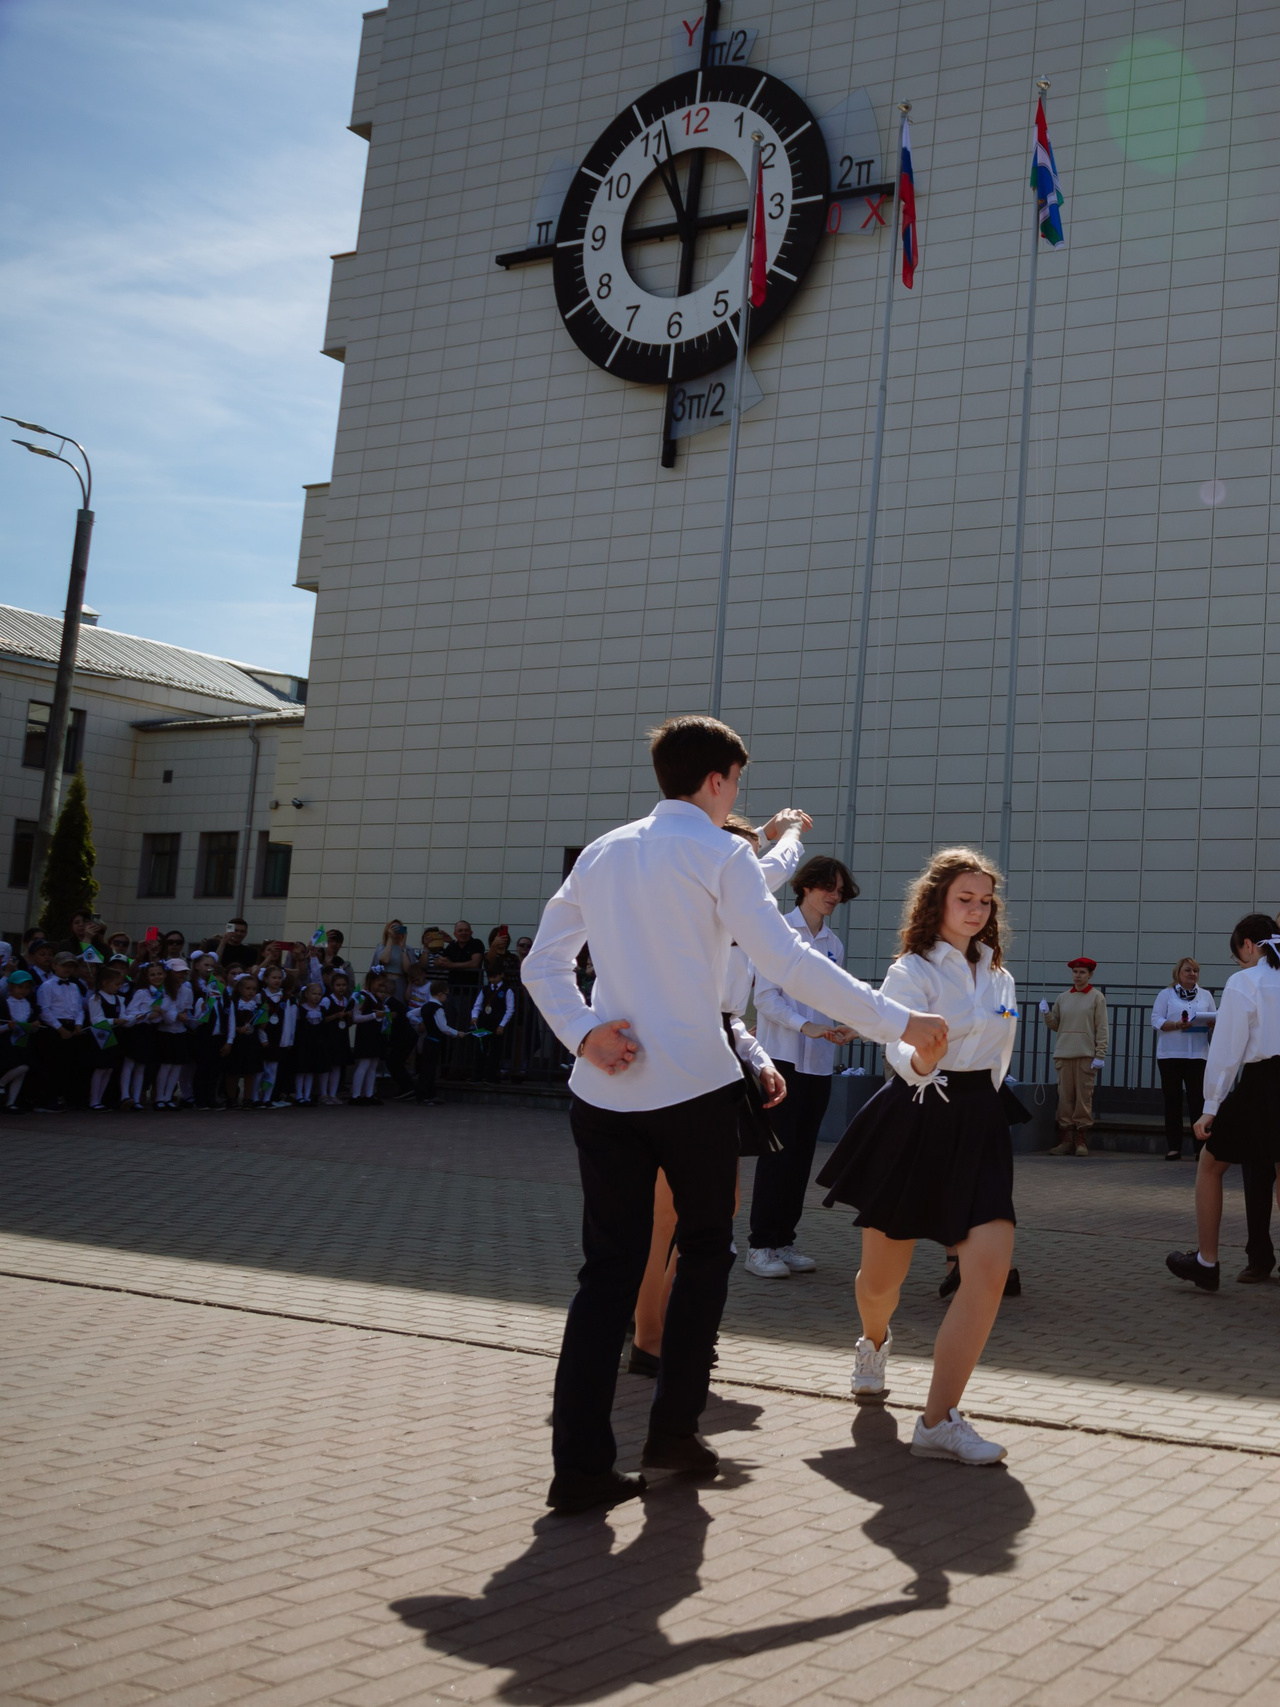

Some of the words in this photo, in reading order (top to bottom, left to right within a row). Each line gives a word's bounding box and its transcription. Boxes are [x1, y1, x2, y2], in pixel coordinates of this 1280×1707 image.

[681, 17, 704, 47] Y
[681, 107, 709, 136] 12
[734, 112, 745, 138] 1
[640, 129, 663, 157] 11
[760, 143, 777, 169] 2
[837, 155, 875, 189] 2π
[604, 172, 631, 202] 10
[768, 192, 785, 220] 3
[860, 195, 888, 229] X
[590, 224, 606, 251] 9
[597, 273, 612, 299] 8
[712, 289, 729, 318] 5
[625, 304, 641, 332] 7
[666, 312, 682, 339] 6
[671, 382, 726, 422] 3π/2
